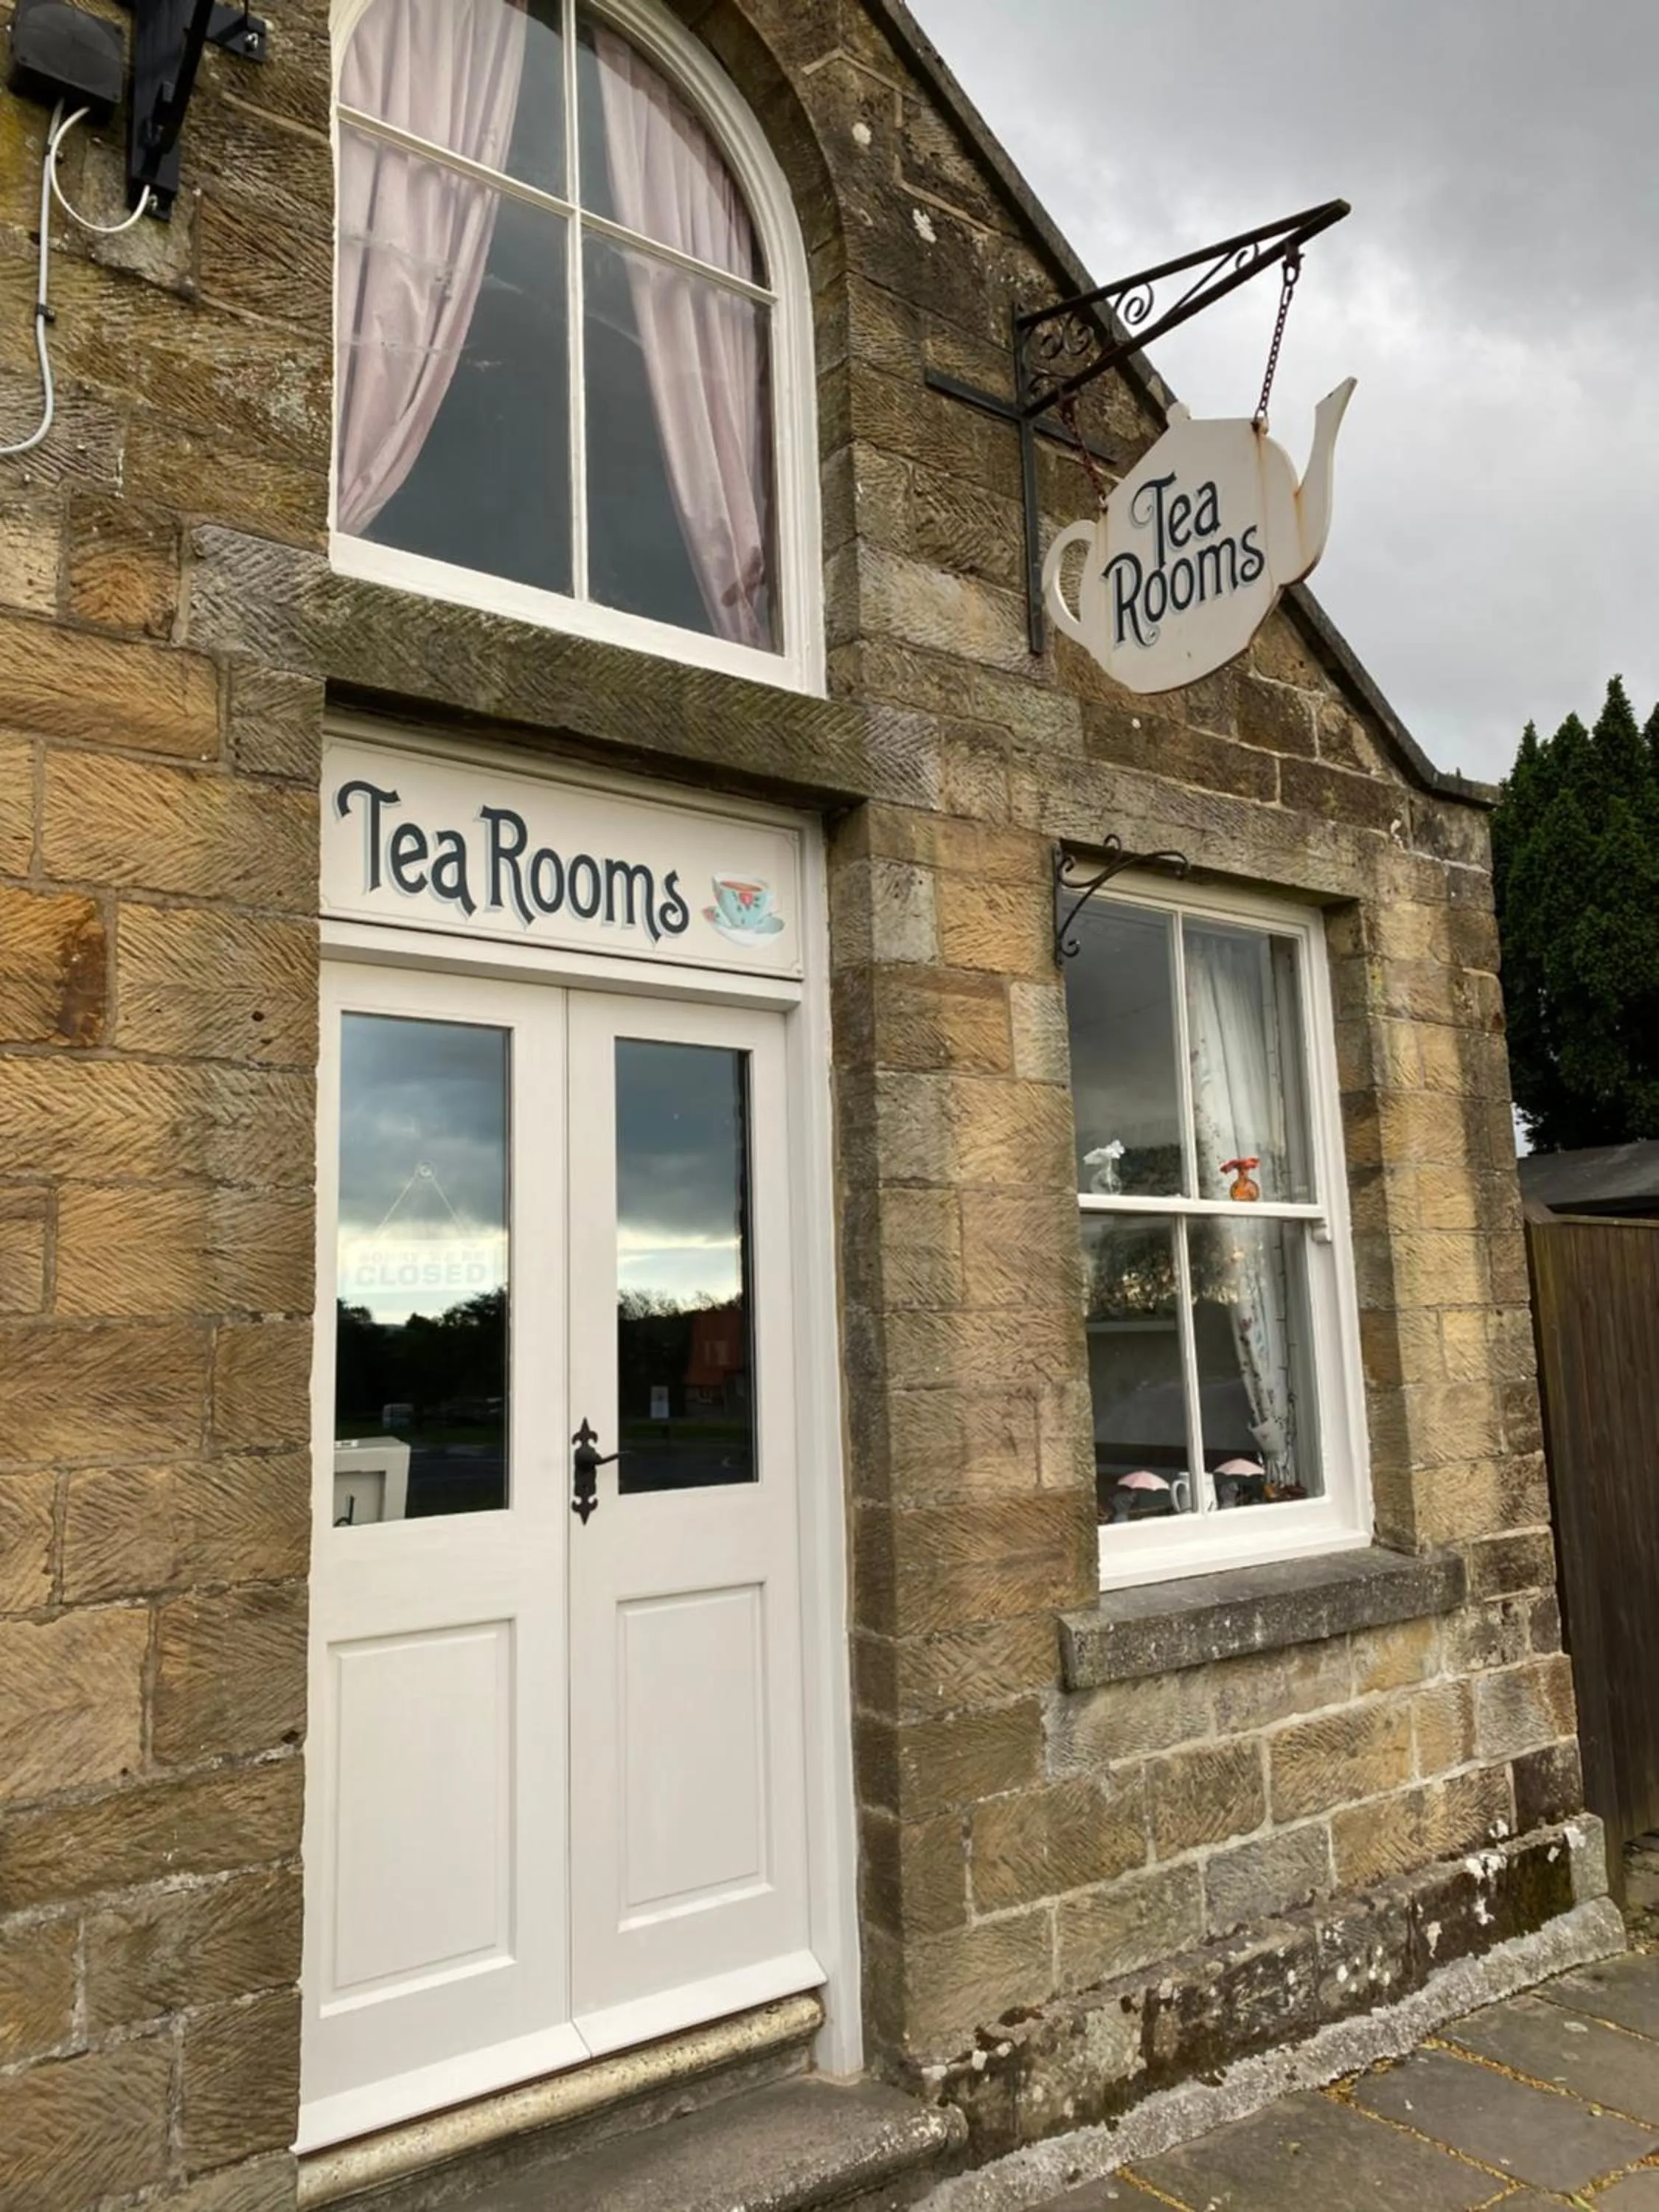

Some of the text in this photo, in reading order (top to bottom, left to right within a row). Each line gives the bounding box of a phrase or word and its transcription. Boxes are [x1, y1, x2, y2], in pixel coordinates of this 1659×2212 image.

[1130, 471, 1221, 570] Tea
[1102, 524, 1265, 647] Rooms
[335, 780, 690, 943] Tea Rooms
[355, 1262, 487, 1286] CLOSED
